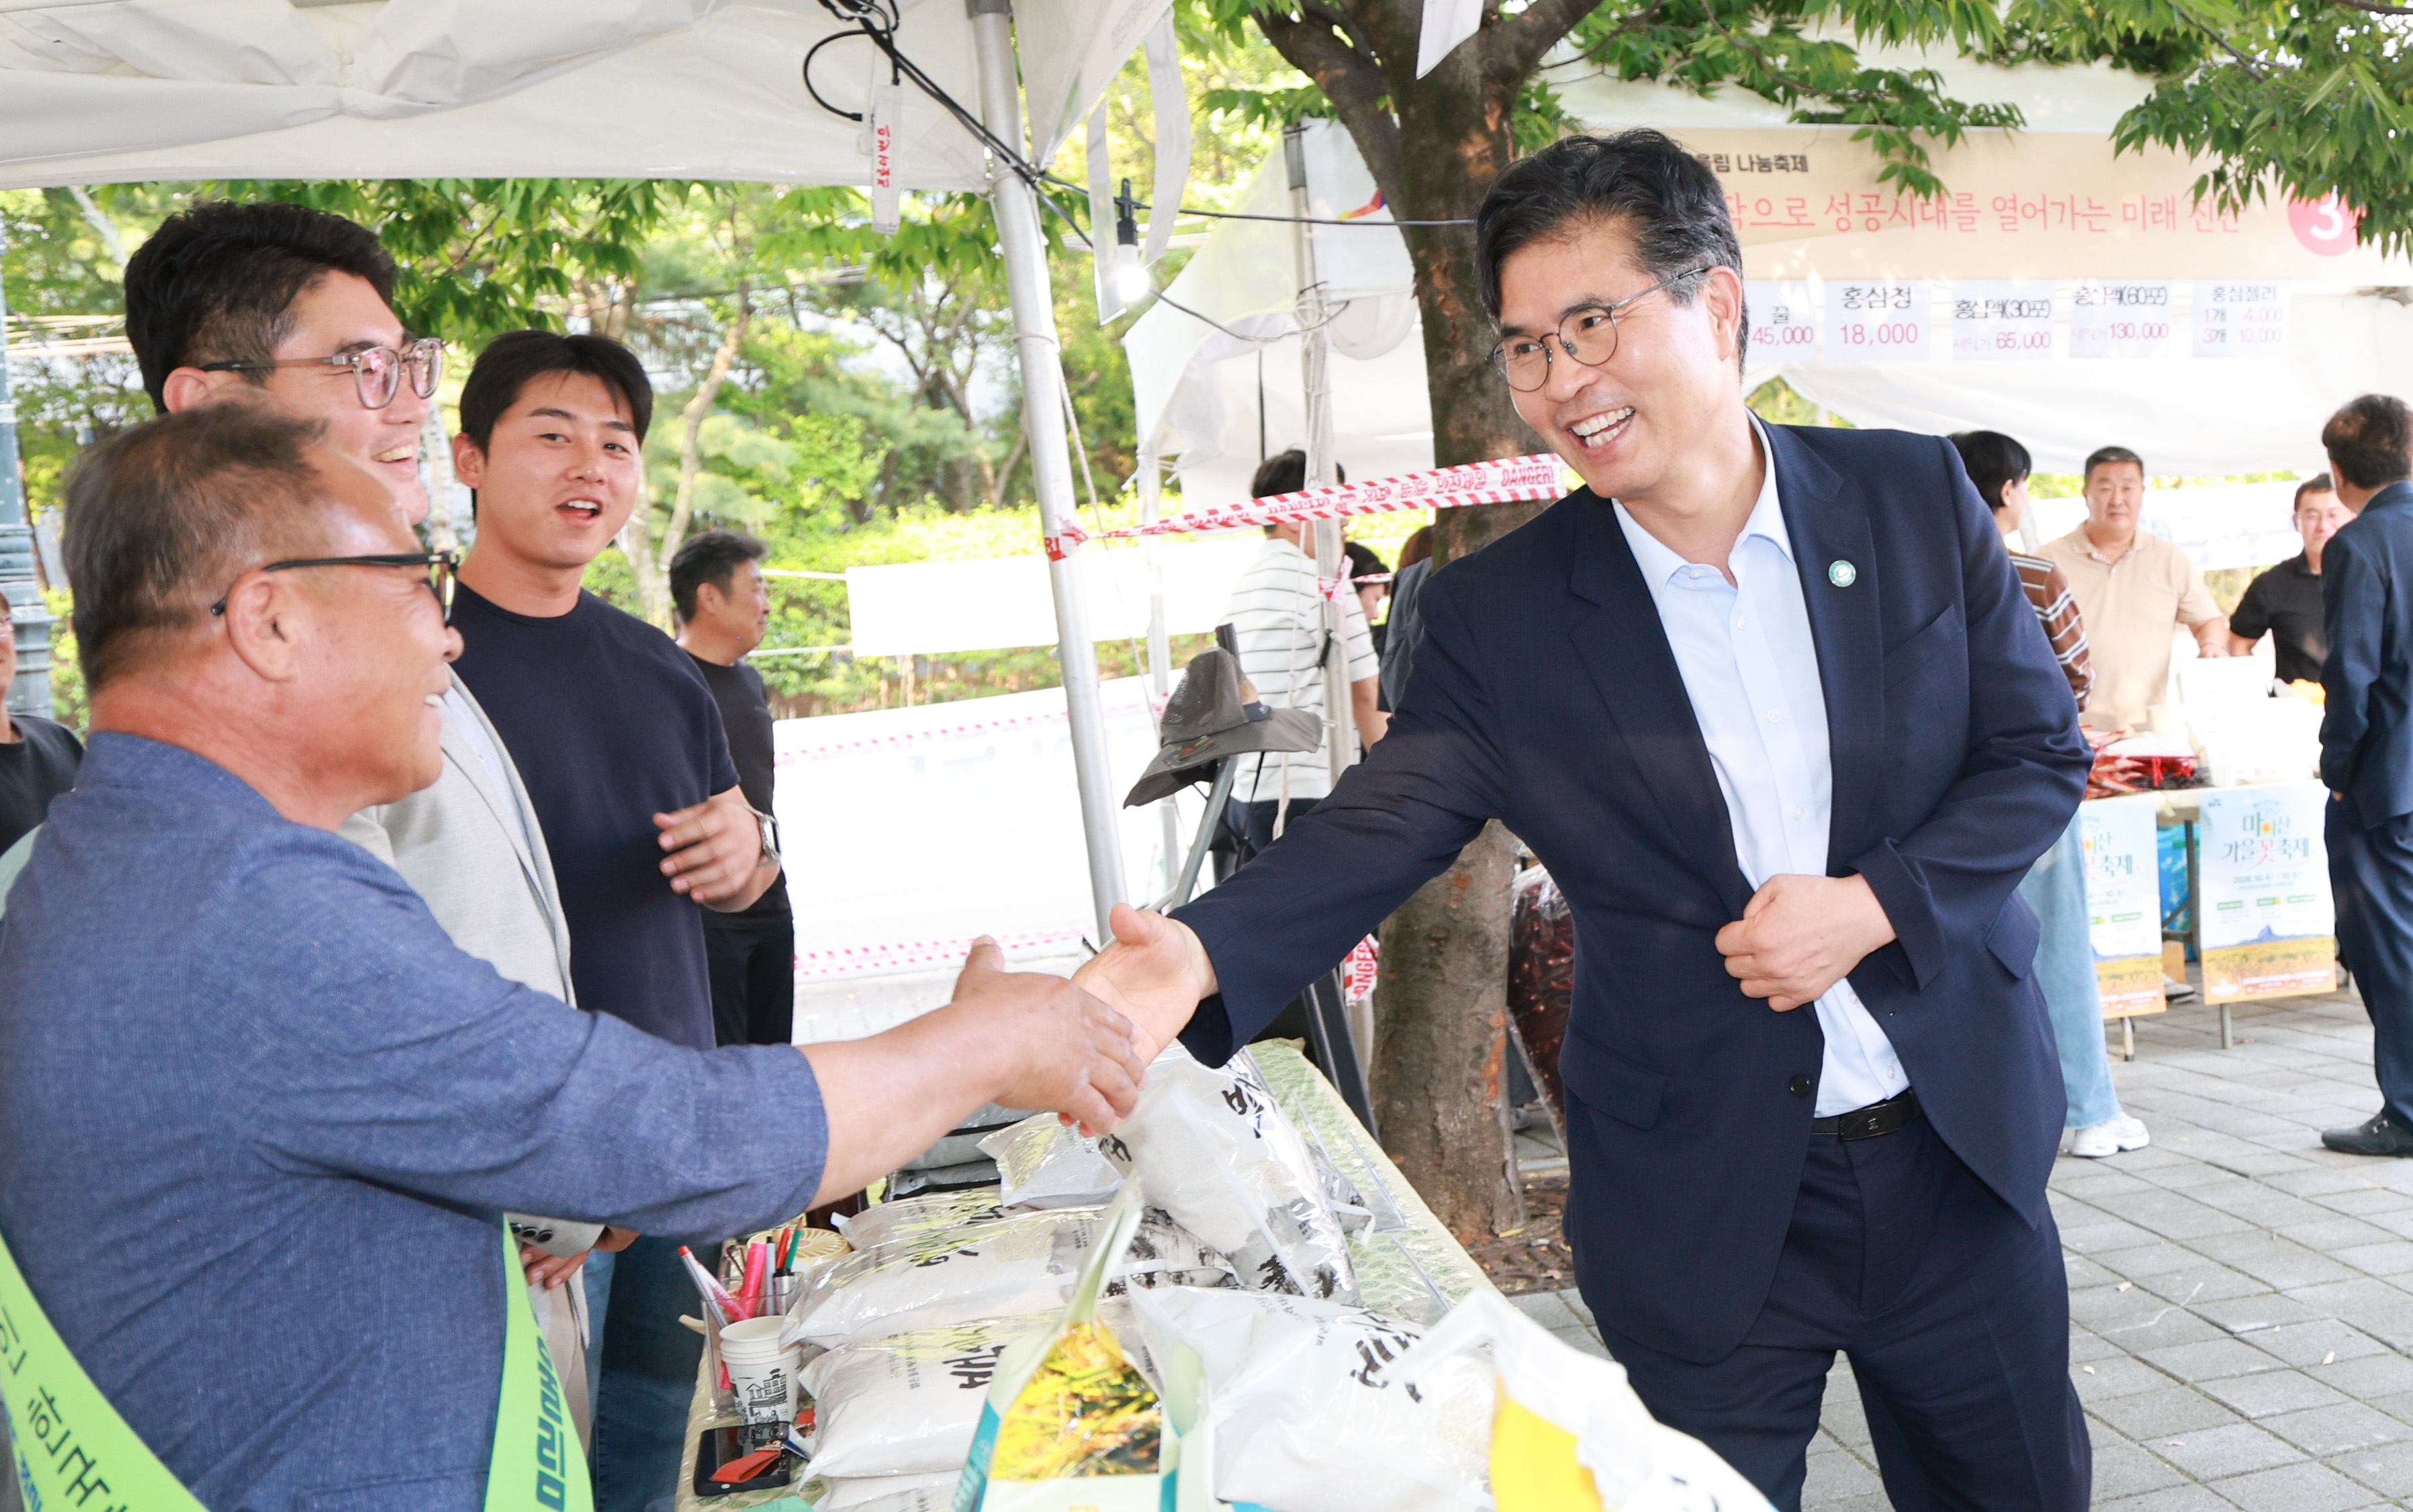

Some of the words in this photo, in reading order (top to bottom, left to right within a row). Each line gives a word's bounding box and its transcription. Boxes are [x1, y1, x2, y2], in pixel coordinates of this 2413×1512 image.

[1736, 154, 1809, 173] 나눔축제
[1723, 191, 1815, 231] 작으로
[1825, 191, 1982, 232] 성공시대를
[1992, 193, 2111, 232] 열어가는
[2123, 194, 2177, 232] 미래
[1841, 286, 1912, 310] 홍삼청
[1772, 306, 1790, 324] 꿀
[2202, 307, 2227, 322] 1개
[2244, 307, 2284, 323] 4,000
[1752, 326, 1814, 346] 45,000
[1840, 323, 1919, 346] 18,000
[1996, 331, 2052, 350] 65,000
[2109, 322, 2169, 340] 130,000
[2238, 328, 2283, 344] 10,000
[1433, 471, 1487, 494] 안전제일
[28, 1384, 128, 1512] 한국
